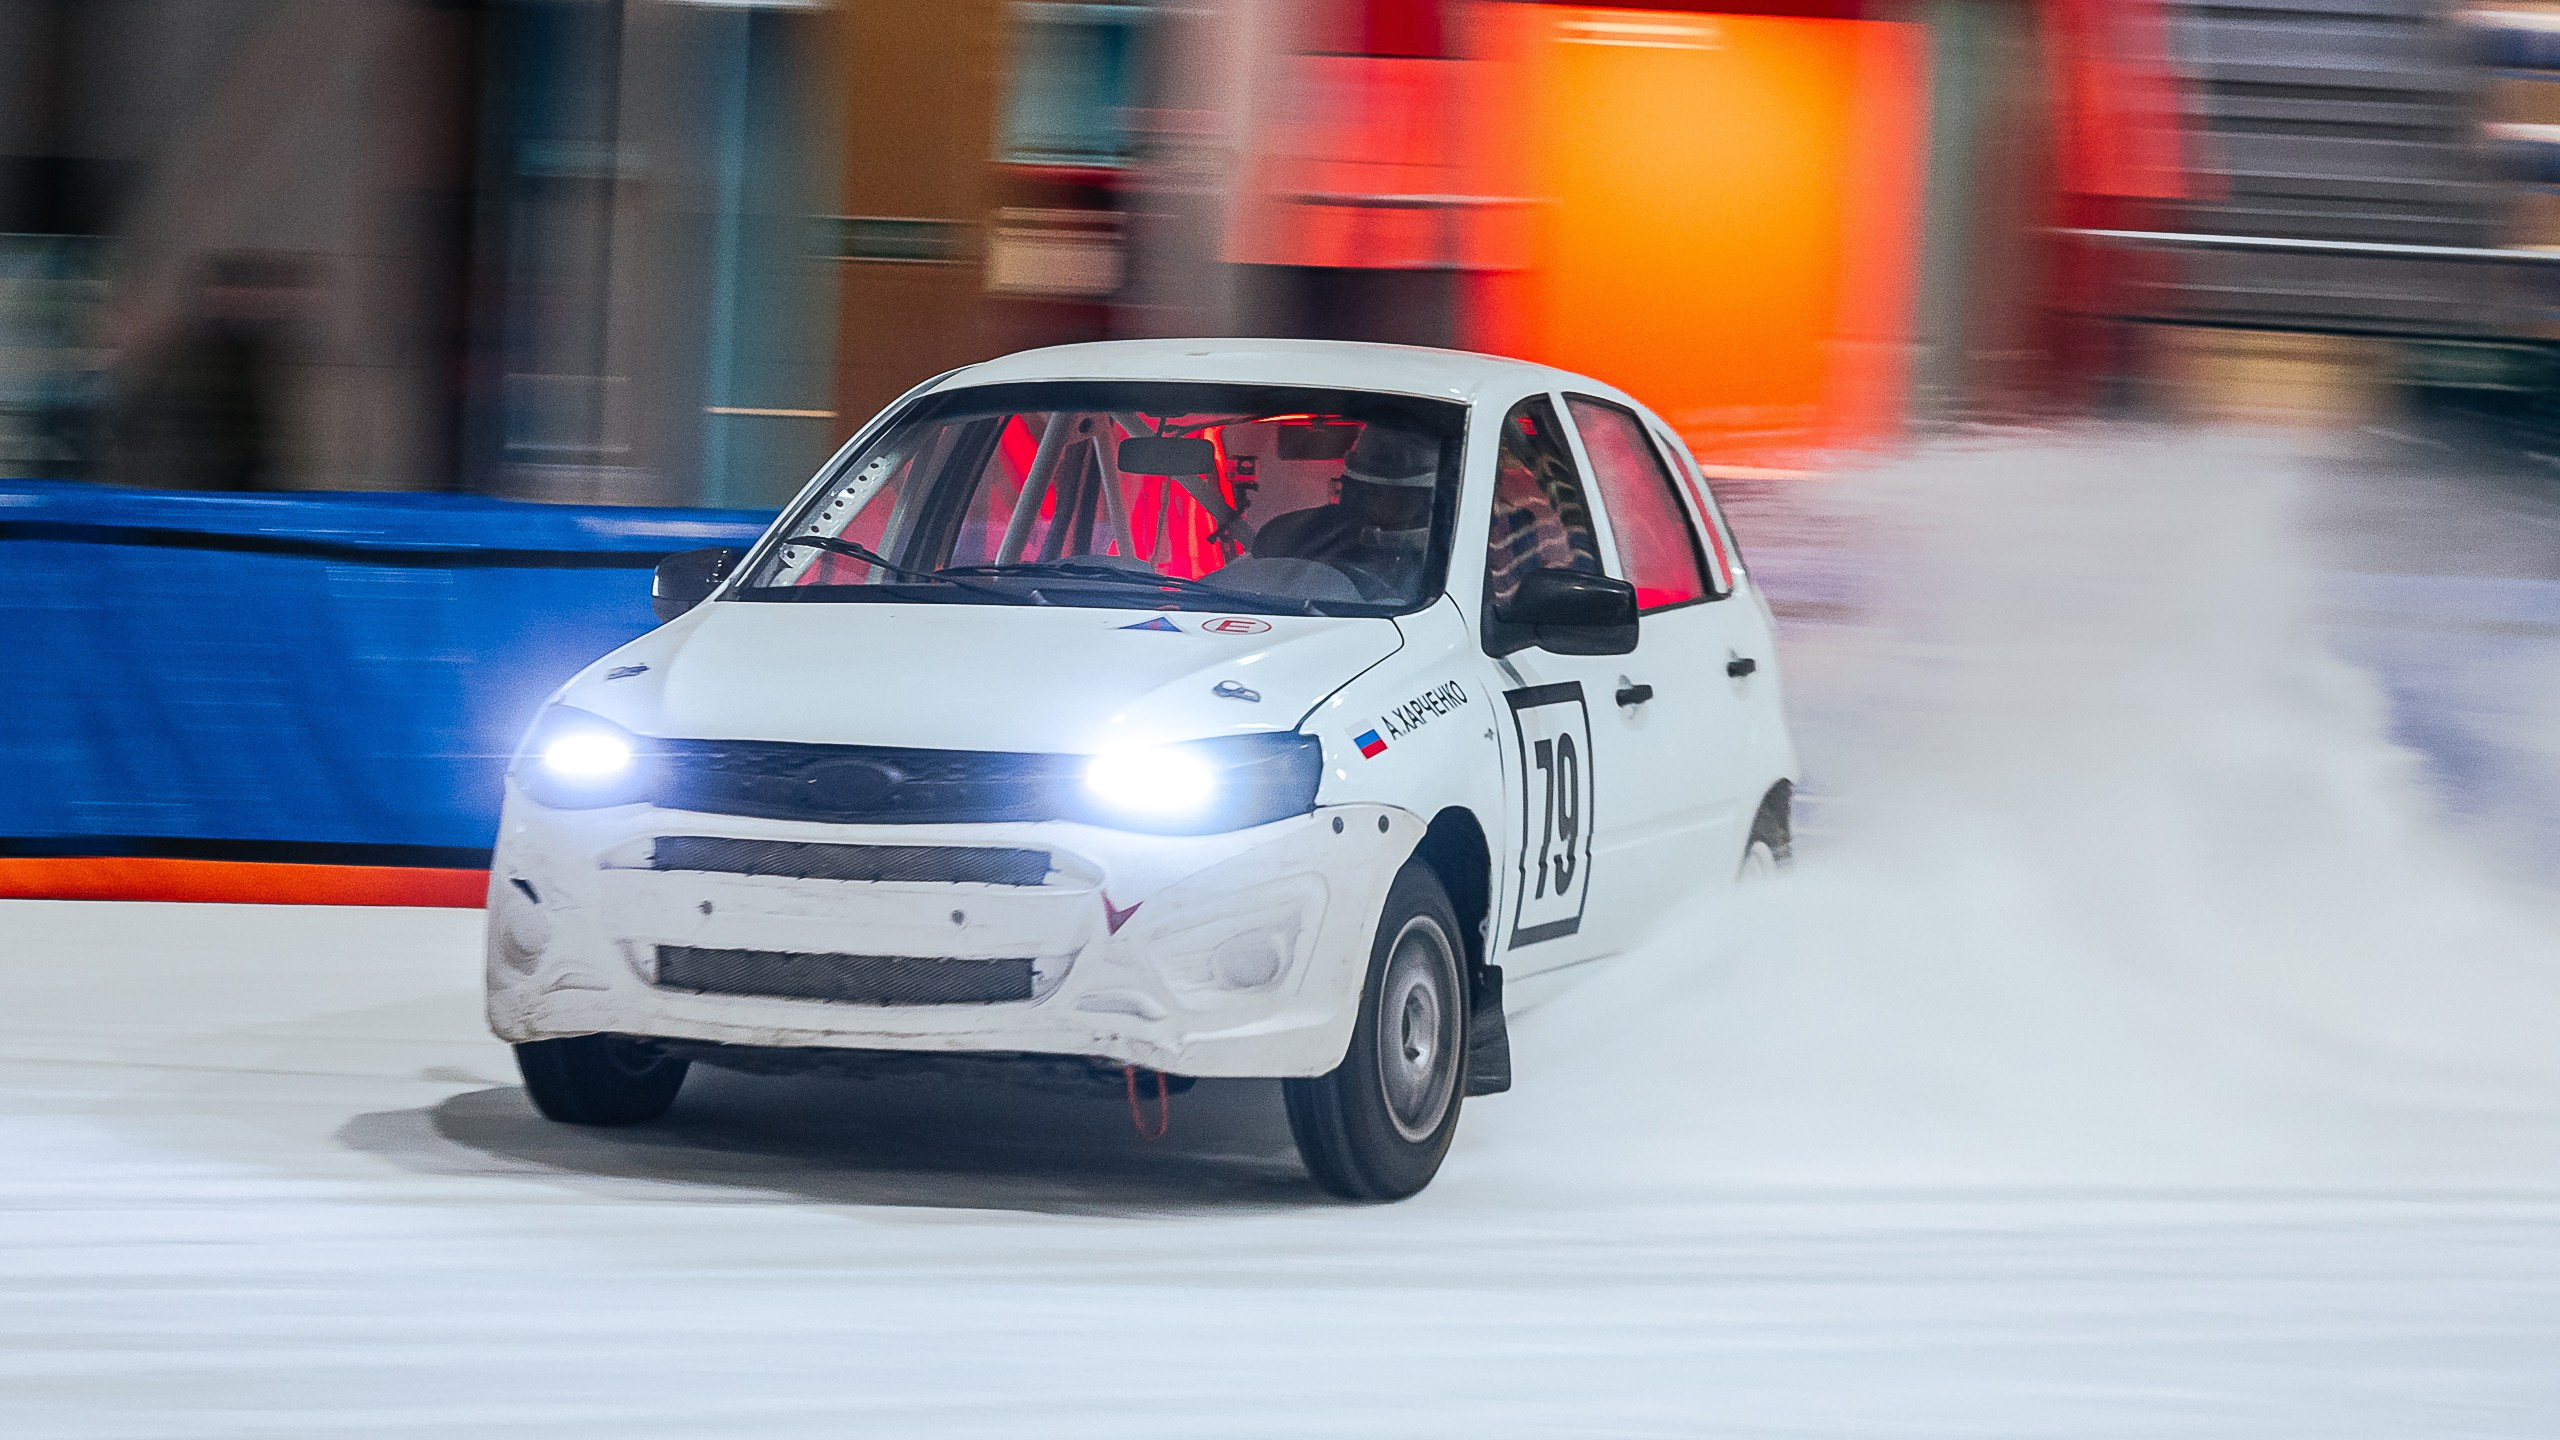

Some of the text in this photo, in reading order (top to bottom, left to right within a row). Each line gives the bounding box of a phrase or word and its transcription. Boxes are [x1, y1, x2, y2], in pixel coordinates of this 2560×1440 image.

[1215, 619, 1256, 633] E
[1381, 680, 1467, 740] А.ХАРЧЕНКО
[1534, 733, 1579, 900] 79
